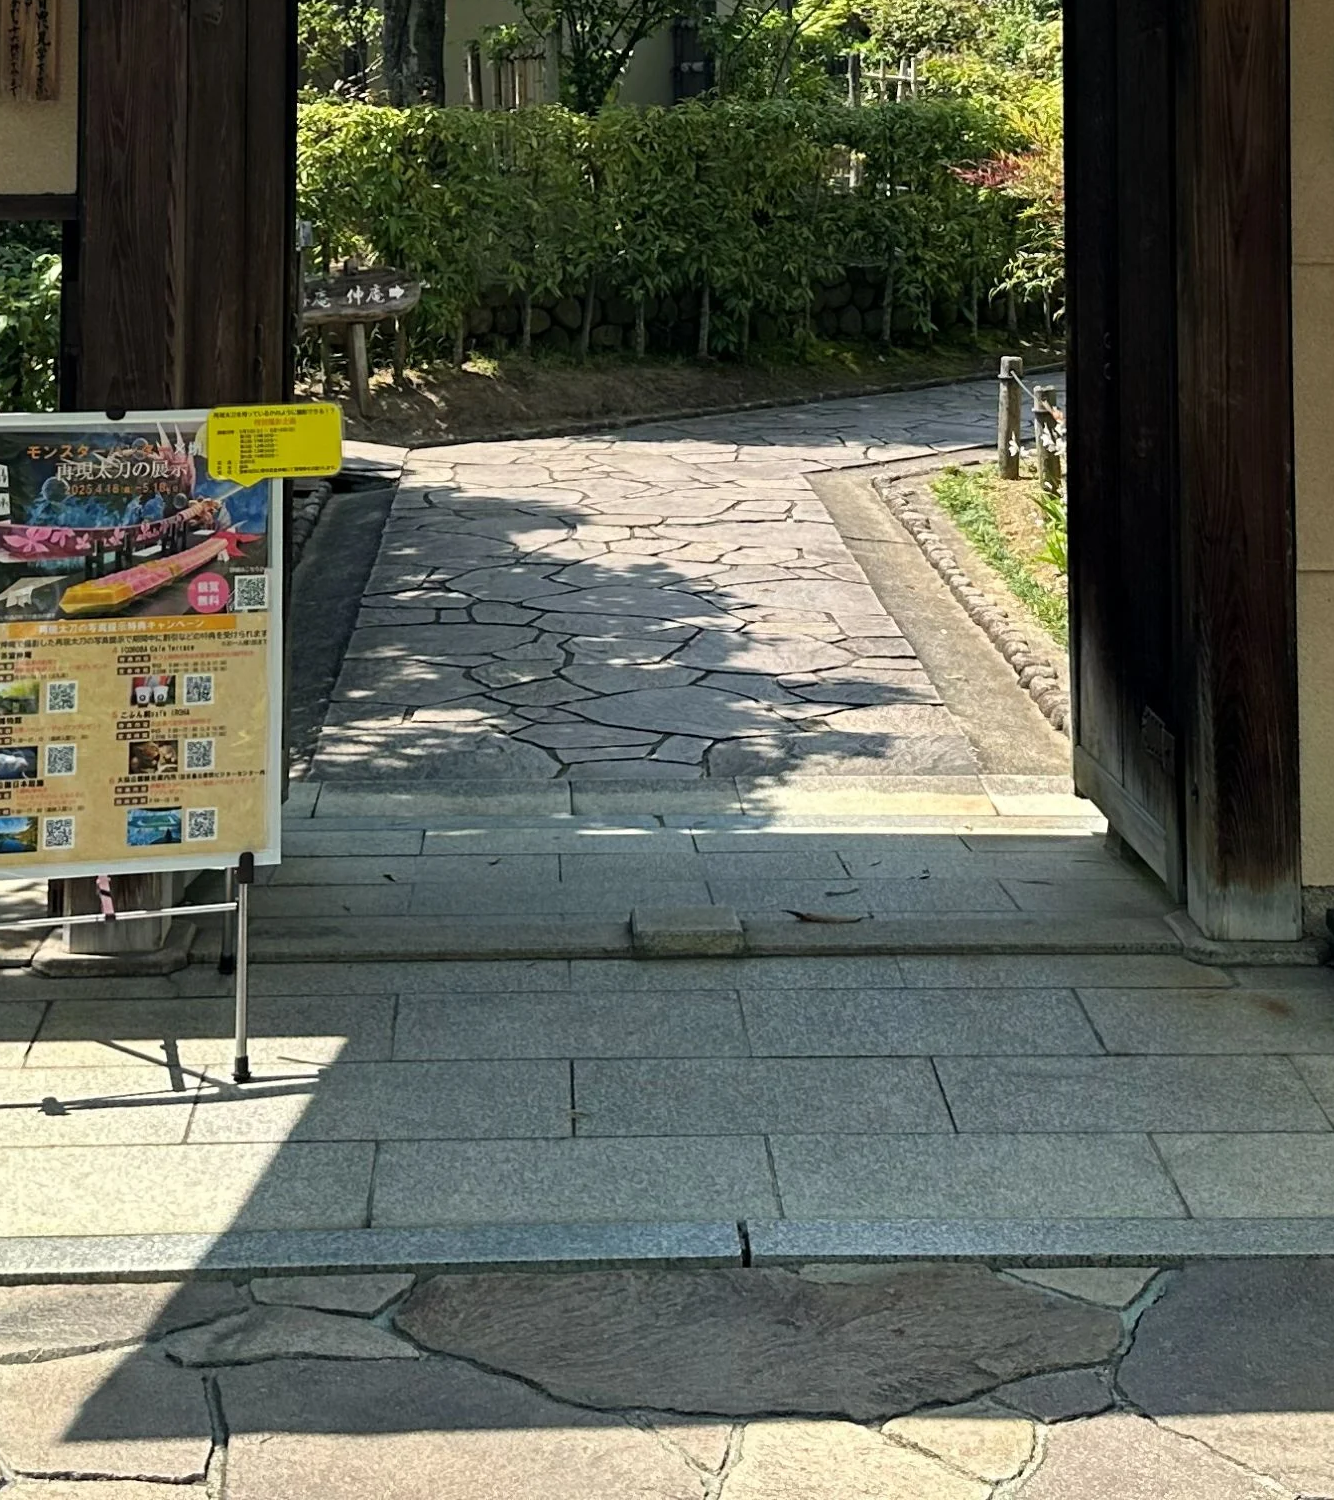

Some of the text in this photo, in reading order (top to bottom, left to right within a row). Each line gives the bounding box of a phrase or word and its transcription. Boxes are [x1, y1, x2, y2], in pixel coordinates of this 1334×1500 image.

[56, 460, 188, 481] 再現太刀の展示
